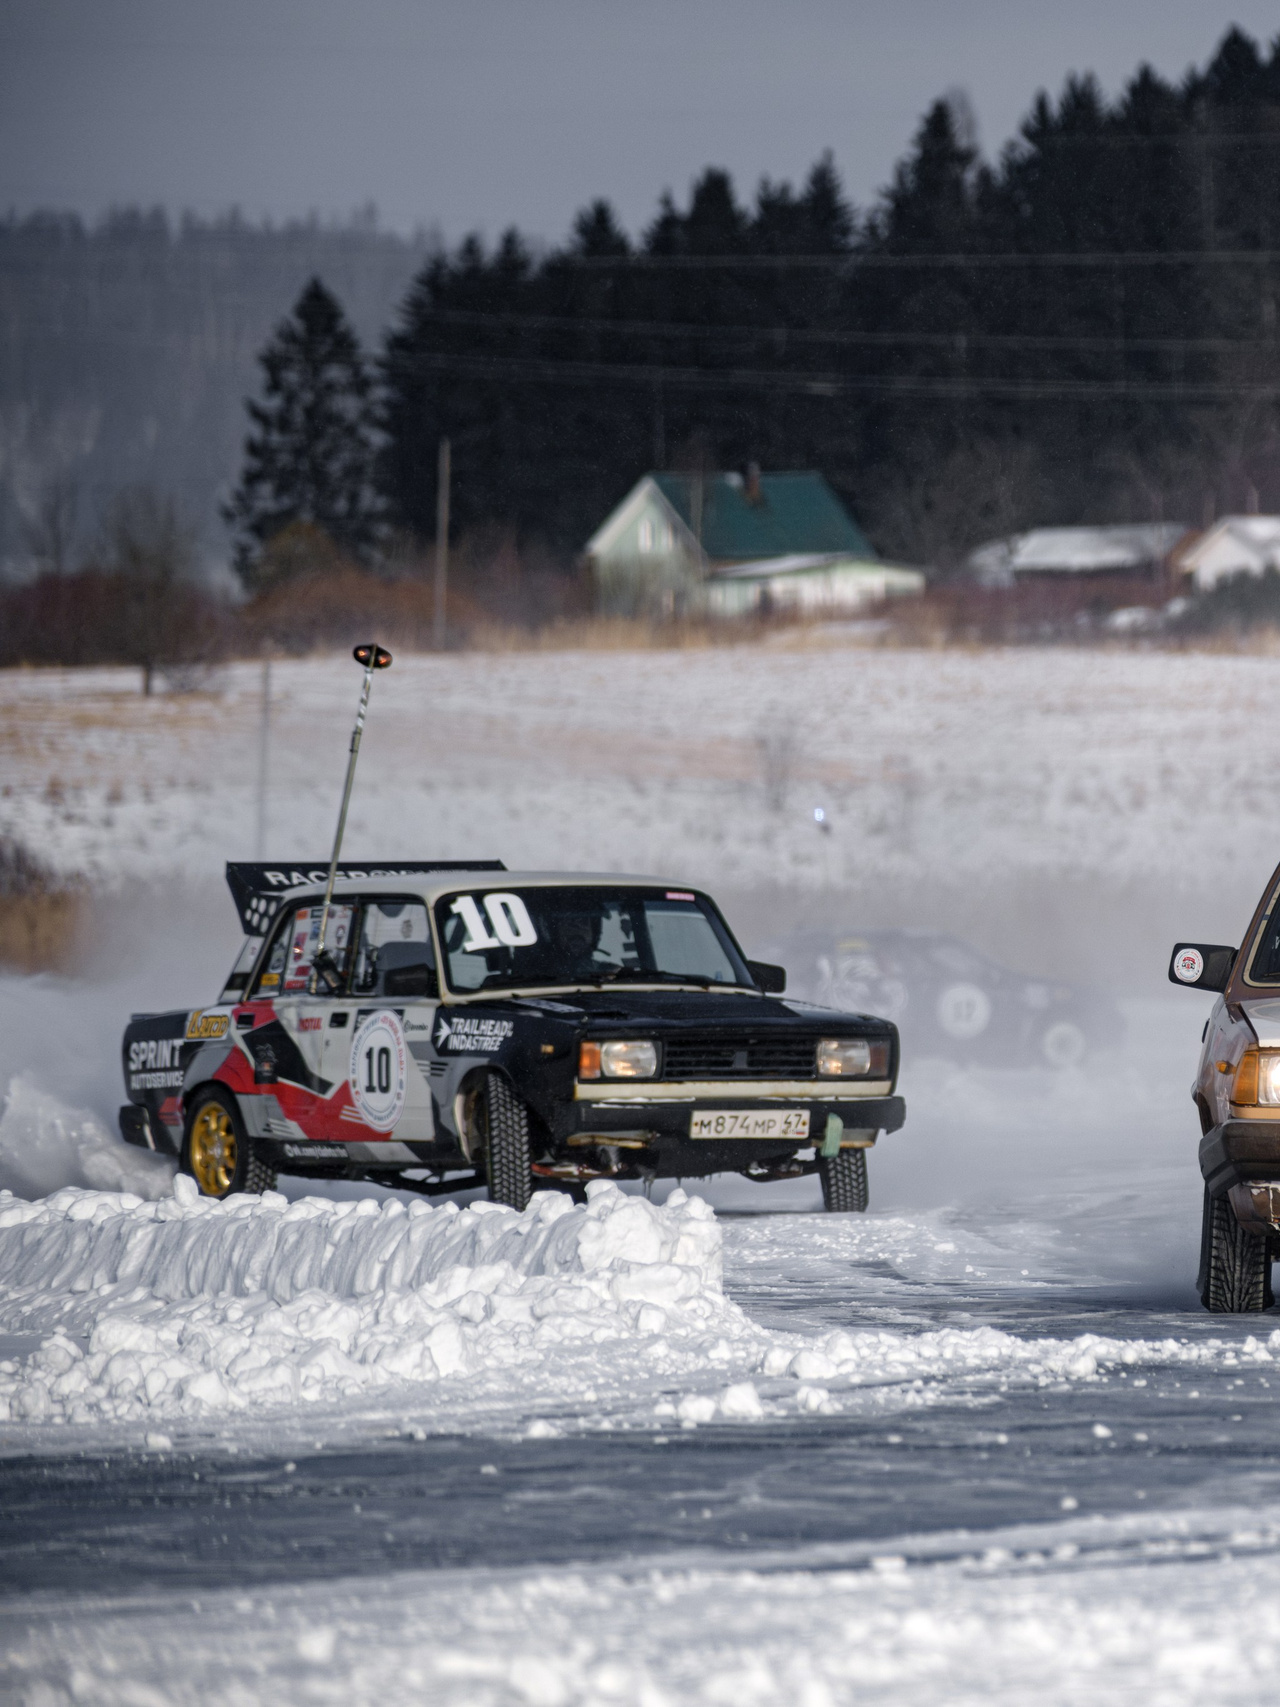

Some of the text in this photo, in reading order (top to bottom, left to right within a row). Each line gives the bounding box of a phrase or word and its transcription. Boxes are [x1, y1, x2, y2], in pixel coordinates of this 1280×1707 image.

[450, 892, 538, 954] 10
[451, 1018, 509, 1036] TRAILHEAD
[448, 1034, 504, 1051] INDASTREE
[129, 1039, 185, 1071] SPRINT
[130, 1070, 185, 1090] AUTOSERVICE
[365, 1047, 391, 1094] 10
[784, 1113, 803, 1130] 47
